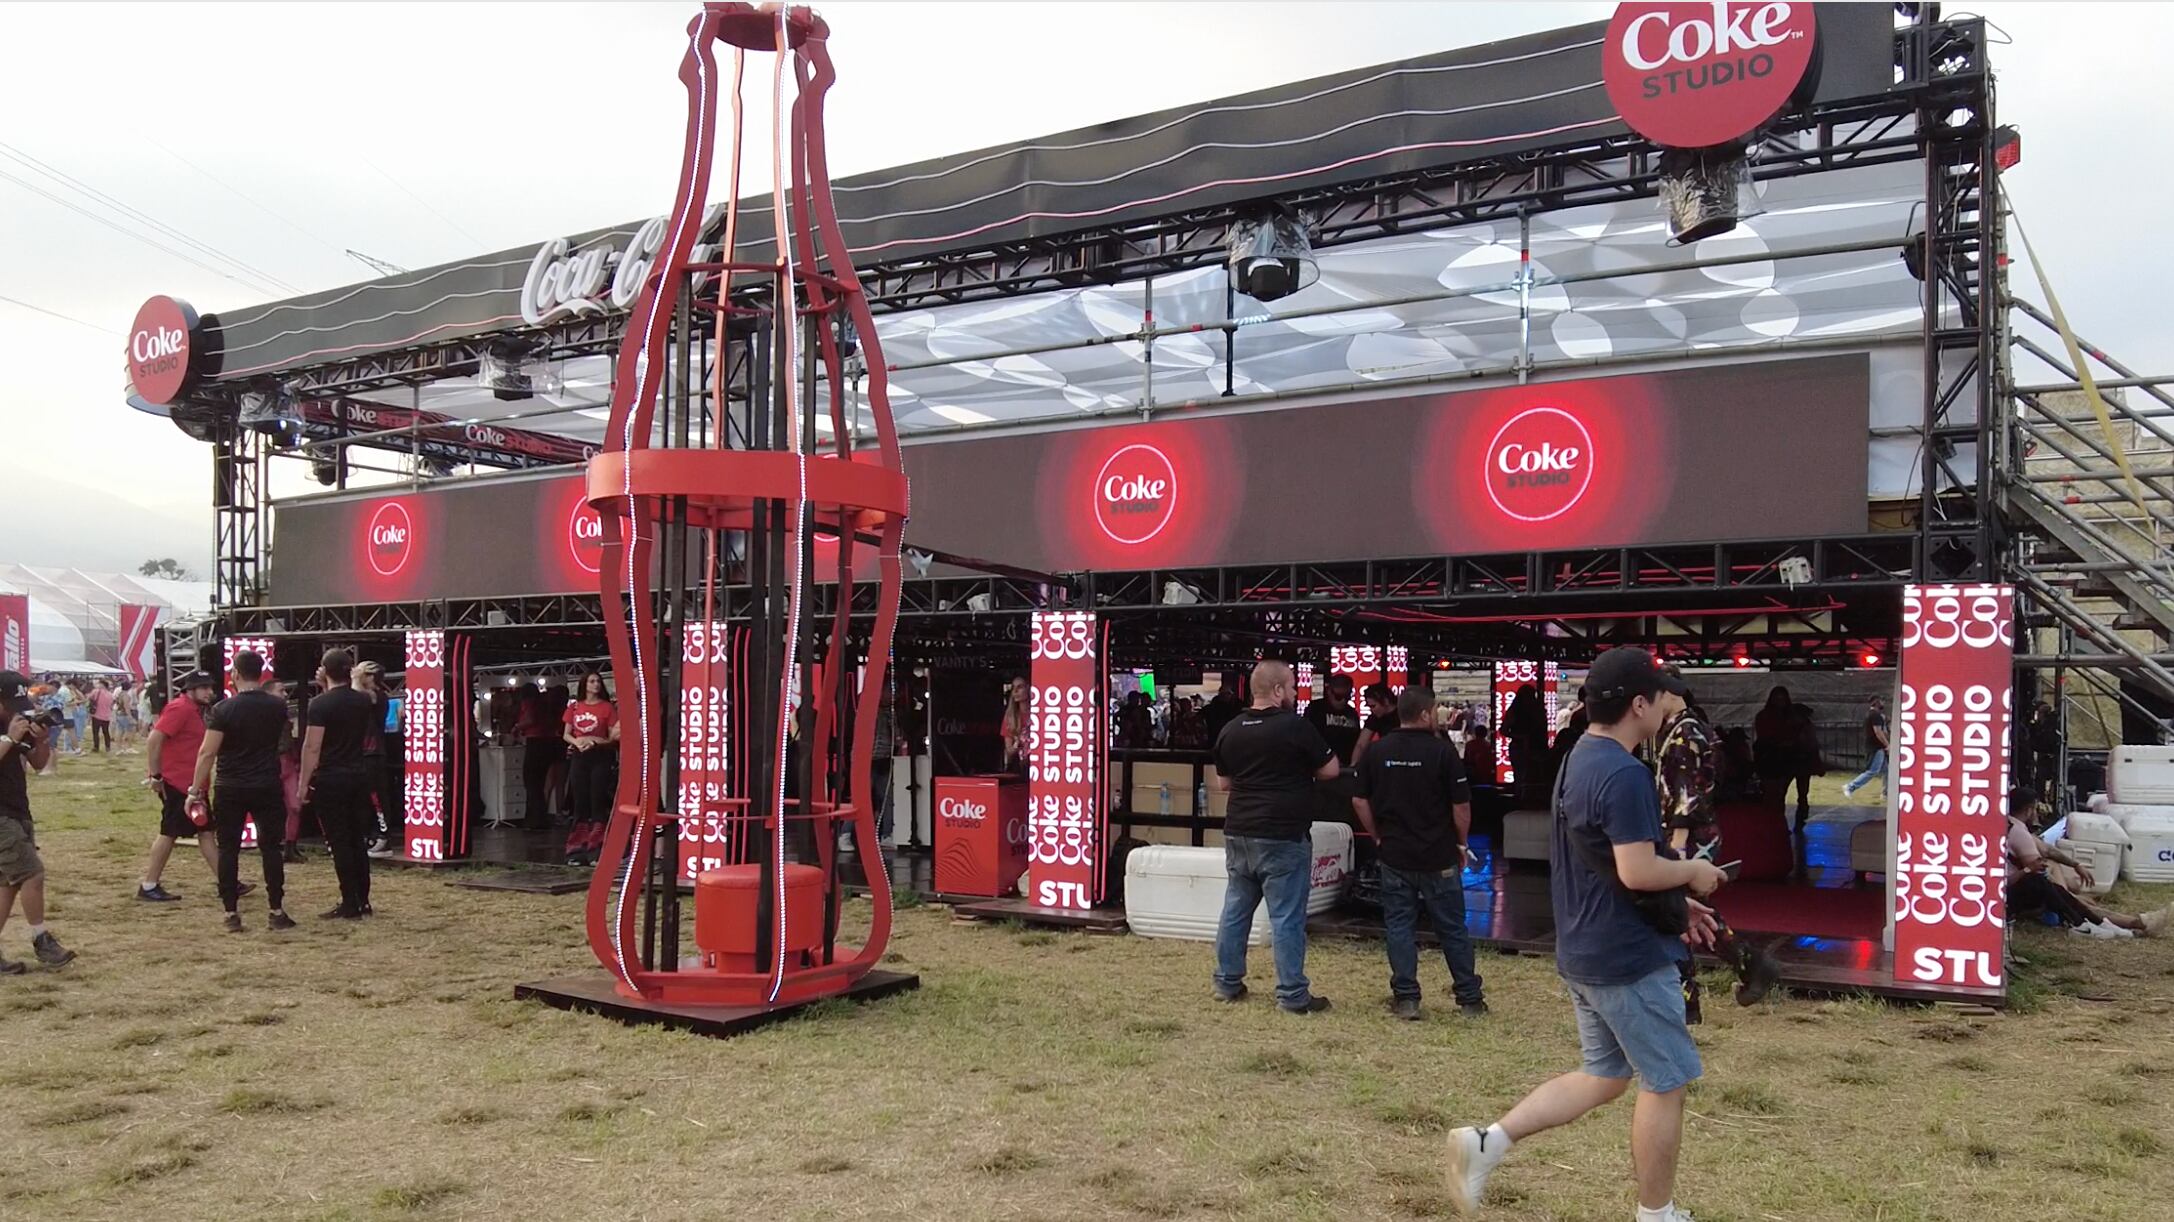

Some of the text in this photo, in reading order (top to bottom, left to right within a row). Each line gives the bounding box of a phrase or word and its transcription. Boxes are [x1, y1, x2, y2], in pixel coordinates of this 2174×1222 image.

[1622, 2, 1792, 70] Coke
[1642, 53, 1774, 99] STUDIO
[133, 325, 184, 363] Coke
[139, 357, 178, 378] STUDIO
[465, 423, 506, 446] Coke
[1498, 442, 1580, 474] Coke
[1104, 474, 1166, 502] Coke
[1506, 472, 1570, 488] STUDIO
[373, 525, 406, 545] Coke
[413, 688, 424, 762] STUDIO
[426, 688, 437, 763] STUDIO
[689, 687, 702, 770] STUDIO
[1043, 686, 1061, 782] STUDIO
[1065, 686, 1083, 783] STUDIO
[1923, 685, 1953, 815] STUDIO
[1961, 685, 1992, 816] STUDIO
[411, 772, 424, 825] Coke
[424, 772, 437, 826] Coke
[940, 797, 986, 820] Coke
[945, 818, 981, 829] STUDIO
[1038, 795, 1059, 864] Coke
[1060, 795, 1081, 866] Coke
[1911, 832, 1949, 925] Coke
[1949, 833, 1988, 927] Coke
